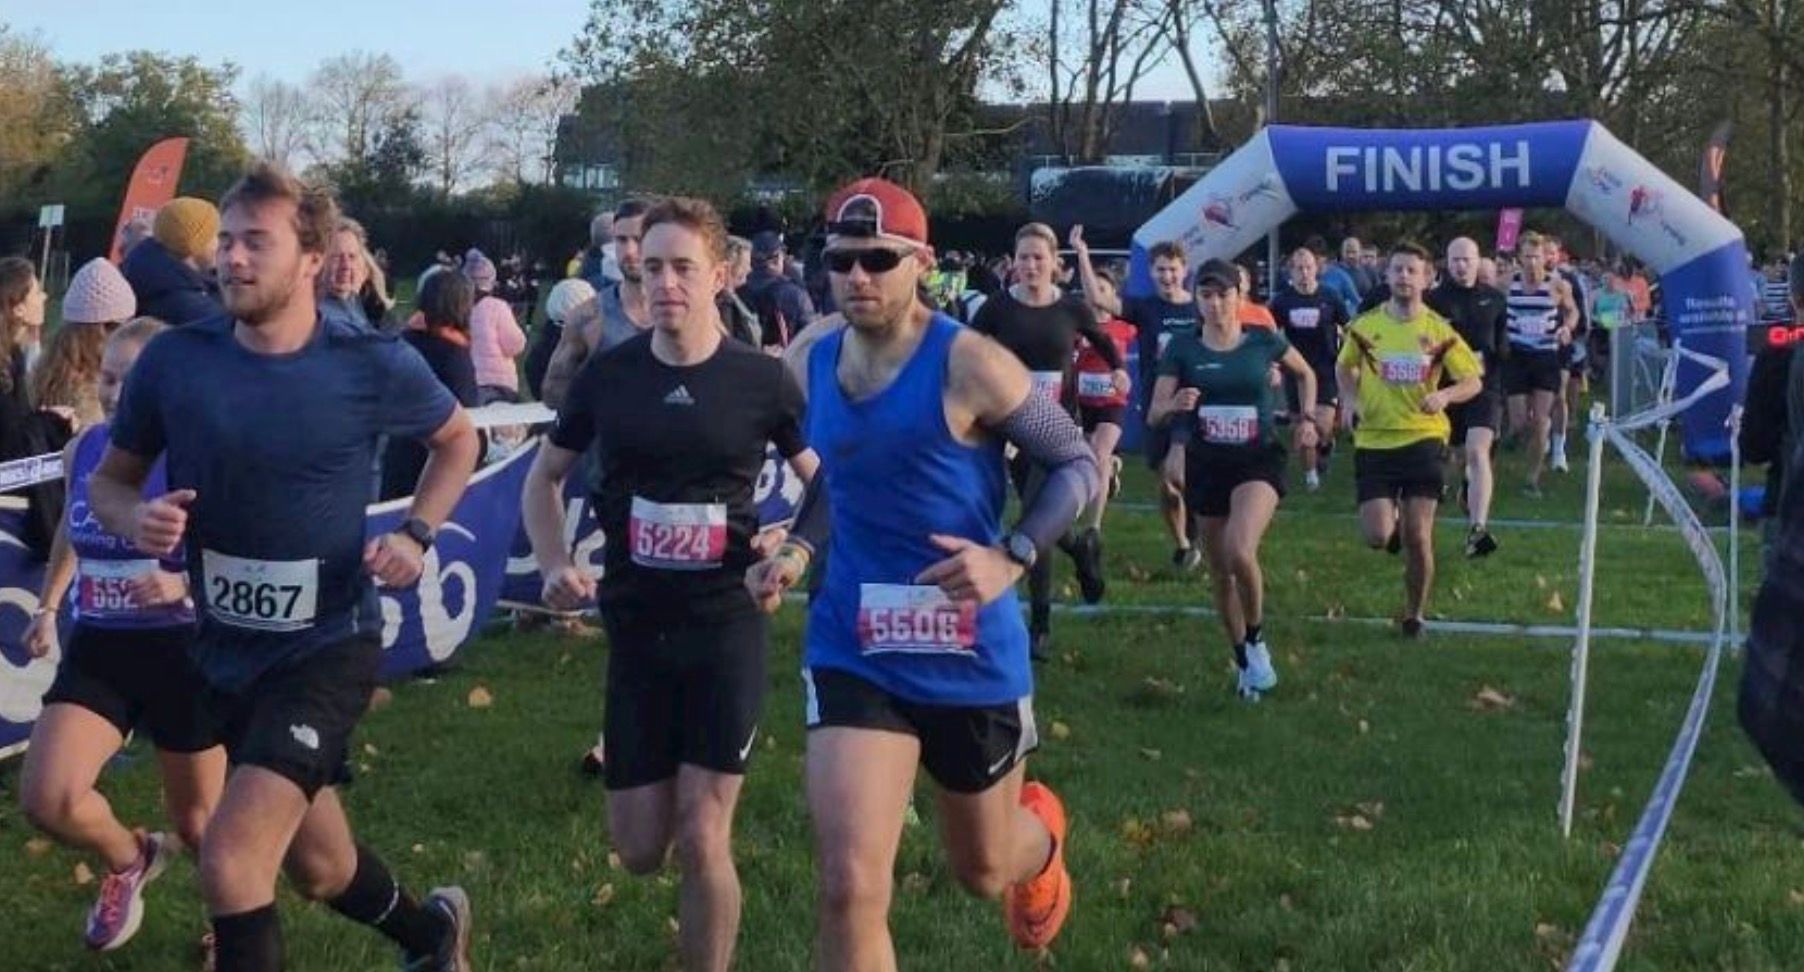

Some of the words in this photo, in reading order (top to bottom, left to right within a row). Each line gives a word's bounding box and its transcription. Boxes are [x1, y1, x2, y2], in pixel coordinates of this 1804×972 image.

[1326, 140, 1530, 192] FINISH
[637, 521, 709, 560] 5224
[212, 576, 303, 619] 2867
[870, 608, 960, 643] 5506
